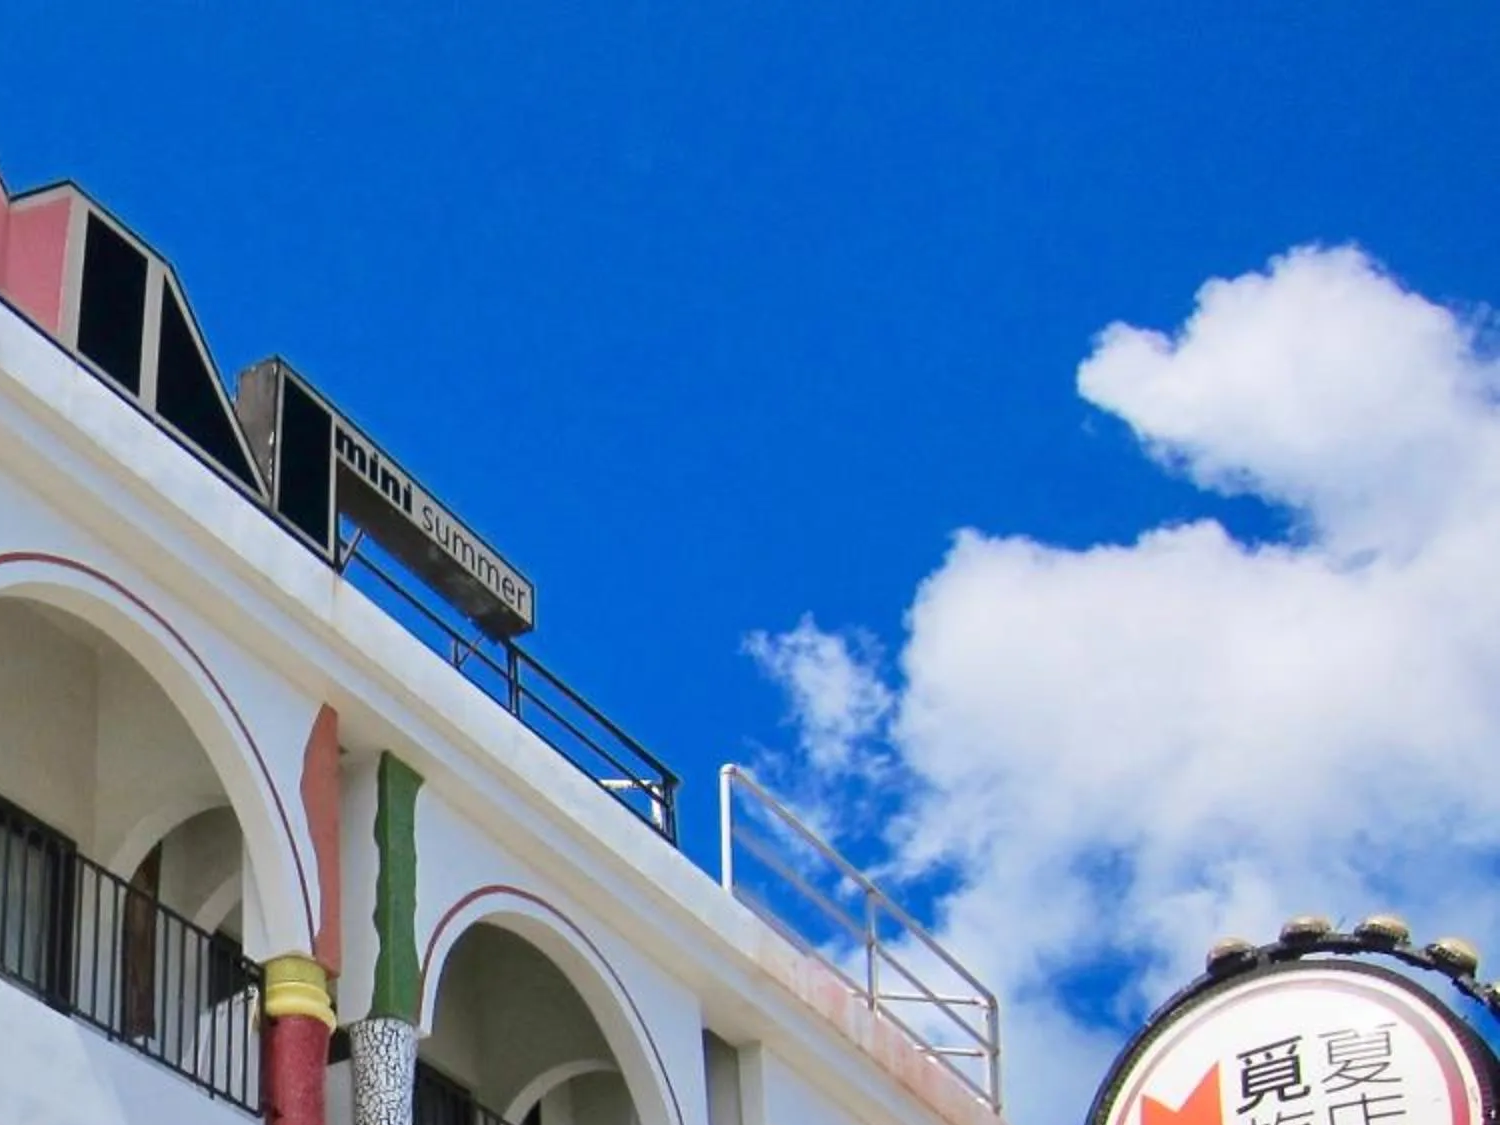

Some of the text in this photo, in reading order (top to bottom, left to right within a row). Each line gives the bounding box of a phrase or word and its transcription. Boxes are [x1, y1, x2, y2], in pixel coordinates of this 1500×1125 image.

[335, 423, 527, 611] mini summer
[1236, 1023, 1403, 1115] 覓夏
